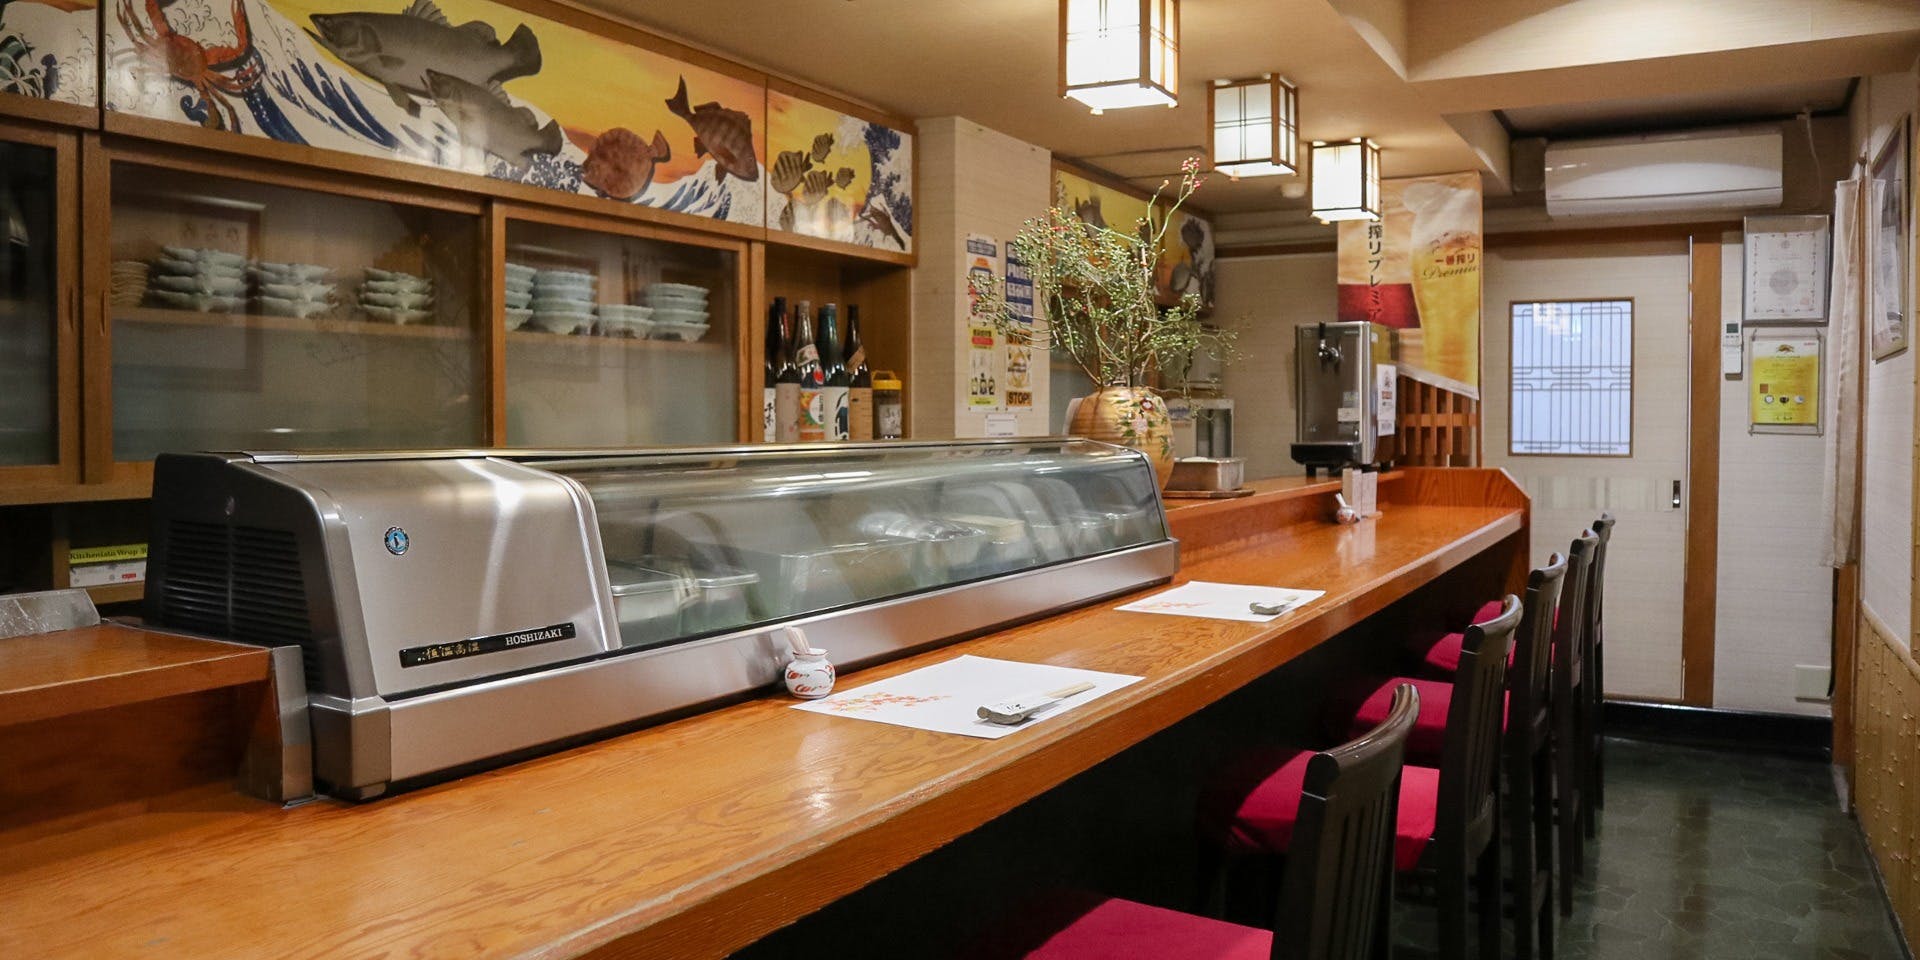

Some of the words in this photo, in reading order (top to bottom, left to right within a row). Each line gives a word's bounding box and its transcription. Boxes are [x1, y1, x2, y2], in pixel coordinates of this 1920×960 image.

[1368, 214, 1383, 321] 搾りプレミア
[1423, 265, 1479, 280] Premiu
[505, 628, 562, 646] HOSHIZAKI
